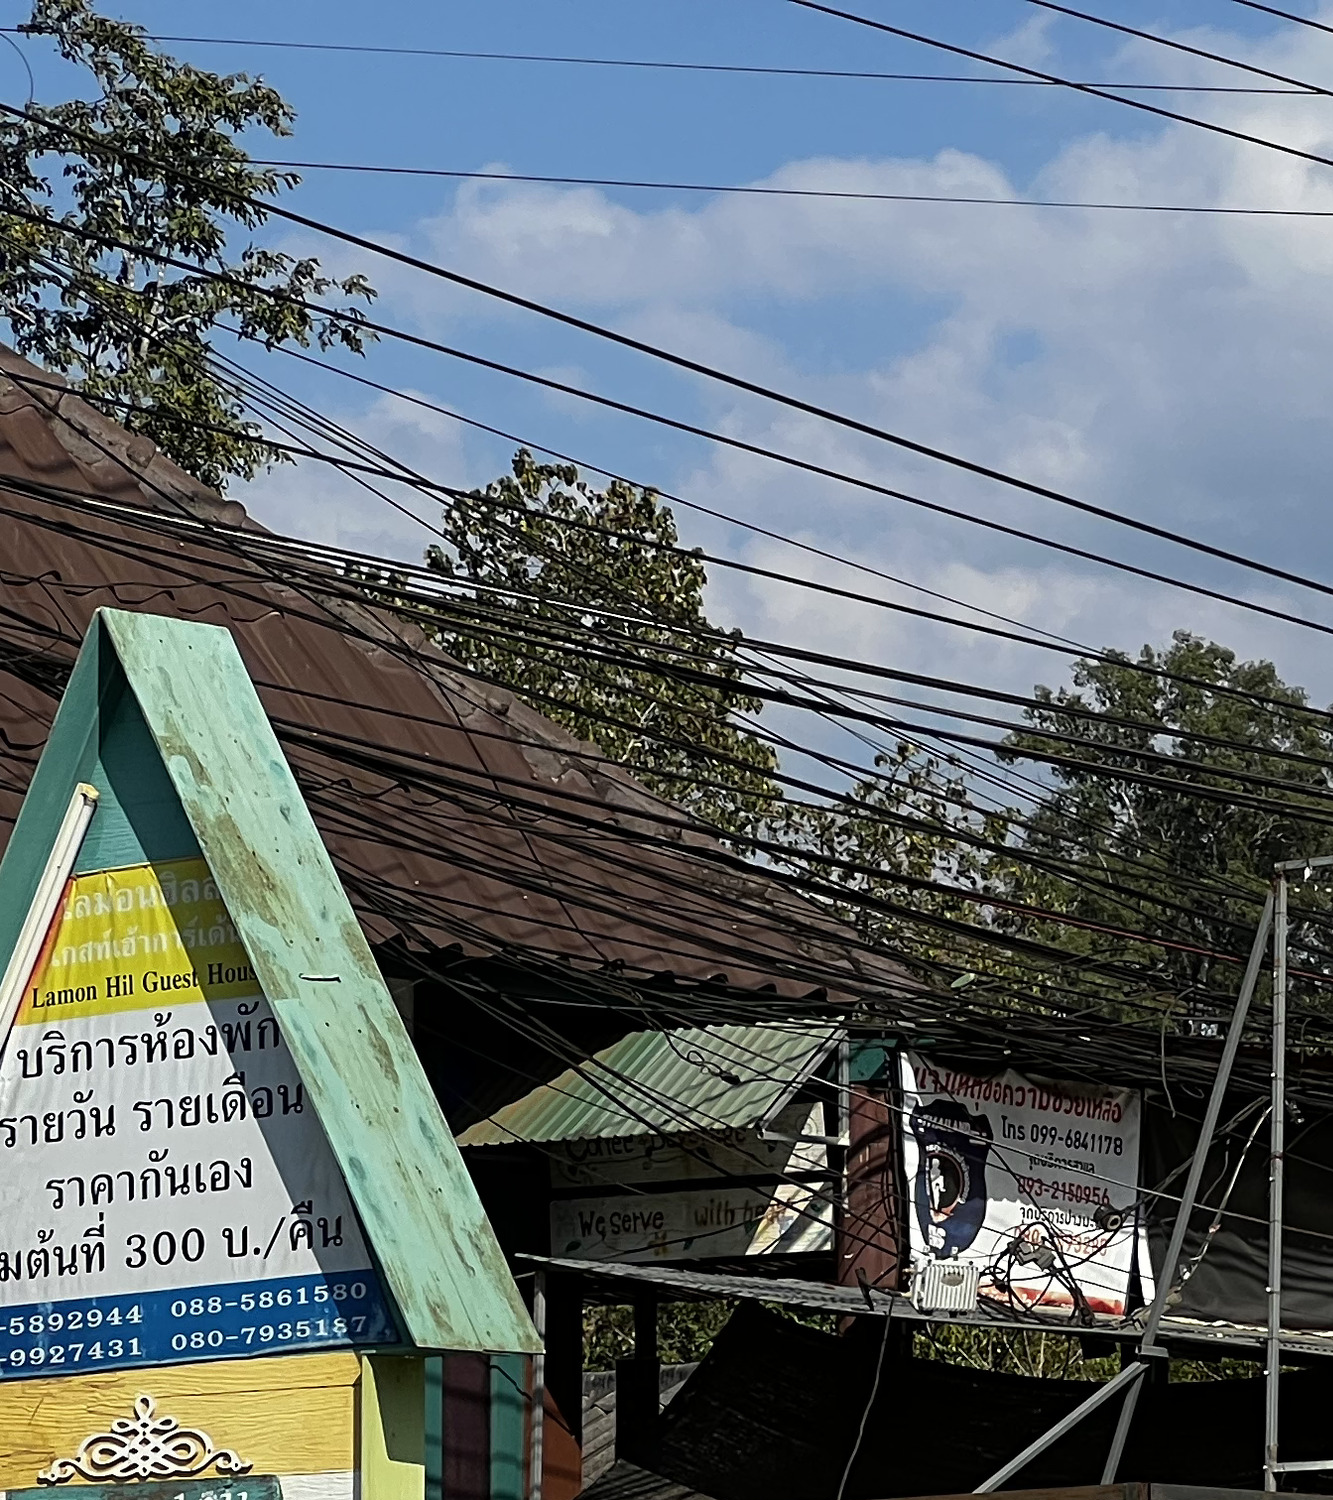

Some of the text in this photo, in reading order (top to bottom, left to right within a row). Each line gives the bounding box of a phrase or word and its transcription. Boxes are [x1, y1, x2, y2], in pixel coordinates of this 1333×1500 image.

[32, 962, 258, 1009] Lamon Hil Guest Hous
[17, 1001, 280, 1079] บริการห้องพัก
[0, 1071, 304, 1148] รายวัน รายเดือน
[1001, 1114, 1123, 1156] โทร 099-6841178
[46, 1148, 253, 1210] ราคากันเอง
[125, 1227, 206, 1269] 300
[579, 1211, 606, 1239] We
[610, 1212, 664, 1235] serve
[0, 1282, 367, 1336] -5892944 088-5861580
[0, 1315, 367, 1368] -9927431 080-7935187
